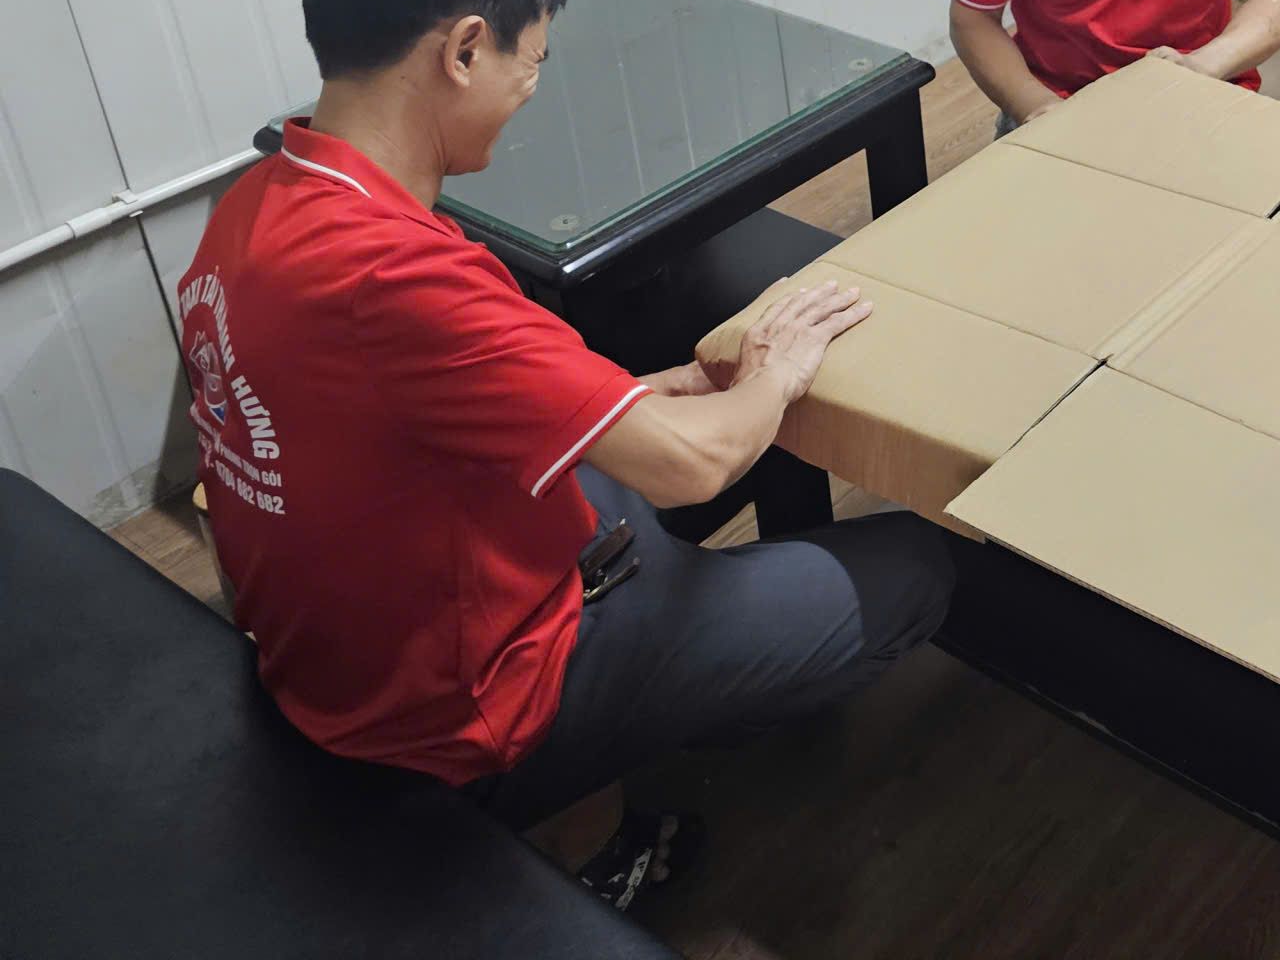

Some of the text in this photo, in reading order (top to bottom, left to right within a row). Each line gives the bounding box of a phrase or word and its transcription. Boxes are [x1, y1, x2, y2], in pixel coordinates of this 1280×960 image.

[231, 375, 281, 459] HƯNG
[261, 470, 283, 487] GÓI
[256, 490, 286, 515] 682
